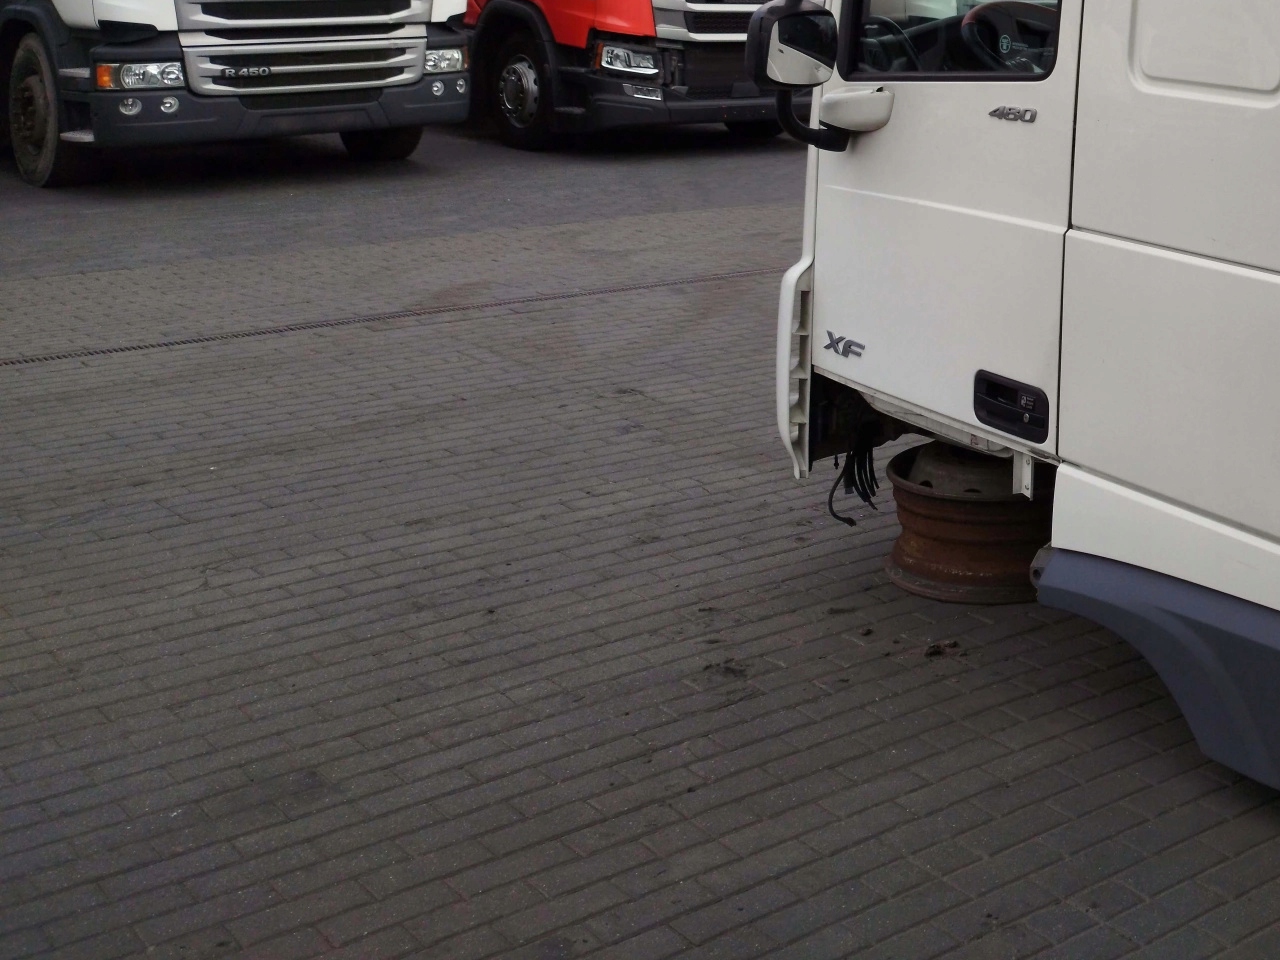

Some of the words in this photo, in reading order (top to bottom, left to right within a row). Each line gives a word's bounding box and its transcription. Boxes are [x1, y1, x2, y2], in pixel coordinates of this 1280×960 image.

[225, 69, 236, 77] R
[239, 67, 269, 76] 450
[823, 329, 866, 358] XF
